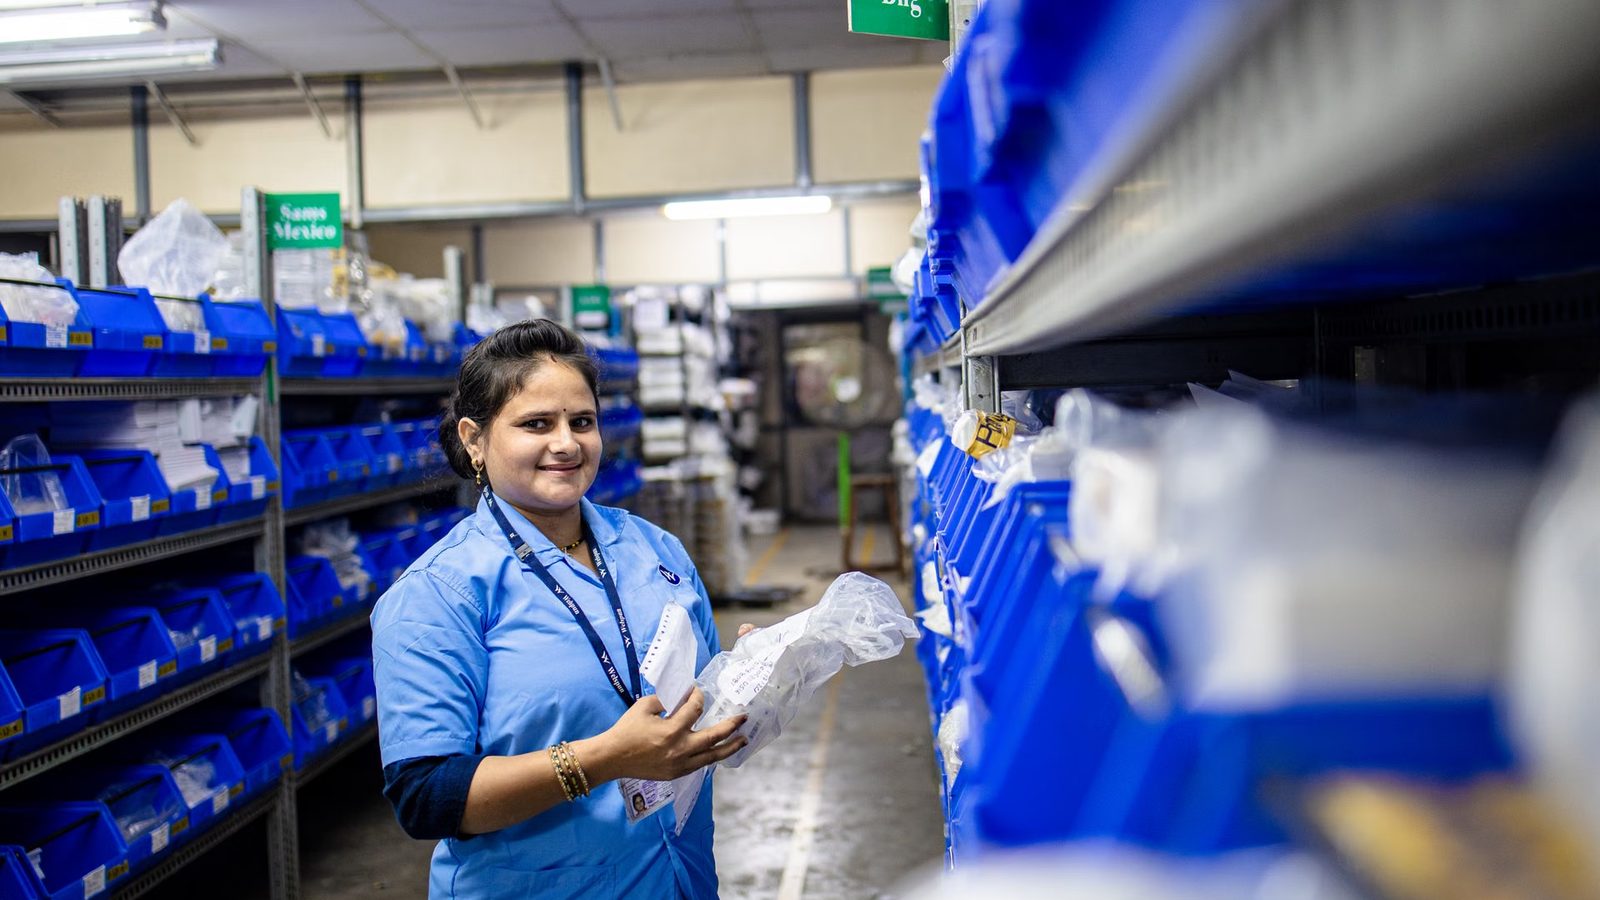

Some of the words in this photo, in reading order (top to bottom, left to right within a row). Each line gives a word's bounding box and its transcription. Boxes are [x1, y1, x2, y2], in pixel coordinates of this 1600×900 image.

[280, 203, 327, 221] Sams
[273, 221, 336, 240] Mexico
[563, 594, 580, 615] Welspun
[616, 608, 628, 633] Welspun
[607, 666, 625, 693] Welspun
